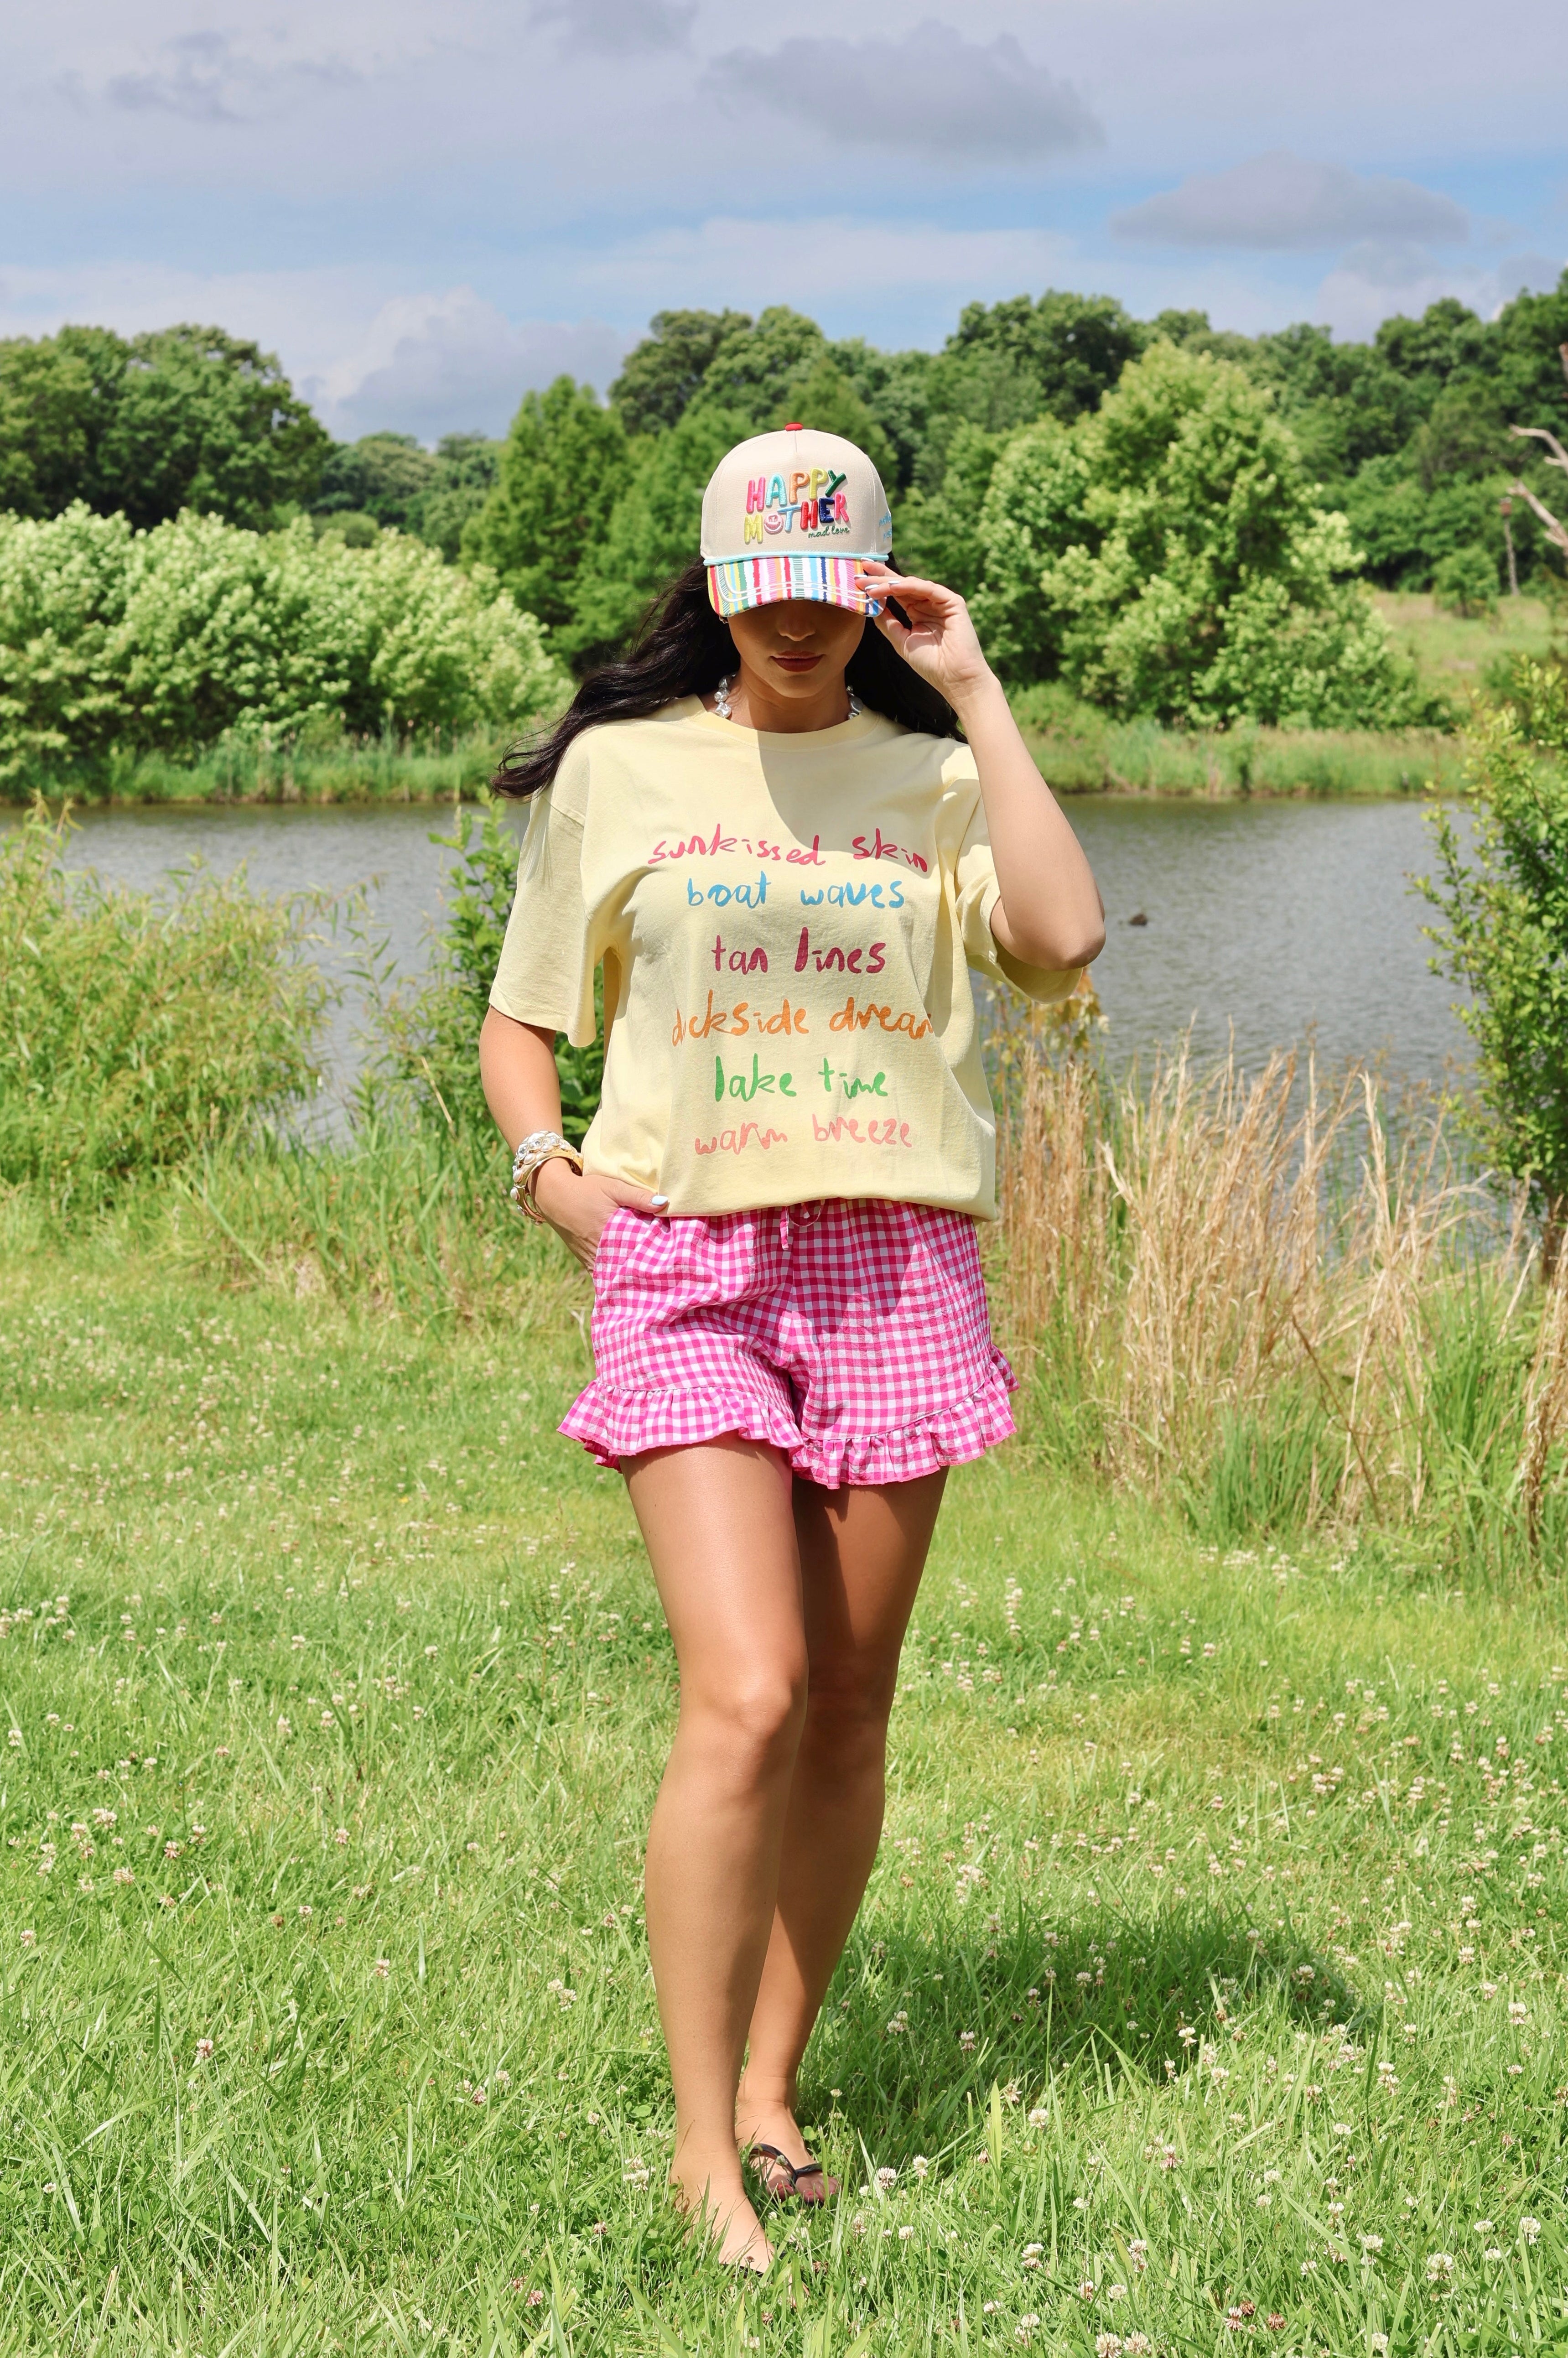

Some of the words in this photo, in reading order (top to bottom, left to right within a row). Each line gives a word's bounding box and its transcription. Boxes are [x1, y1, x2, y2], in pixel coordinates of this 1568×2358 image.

[747, 467, 847, 514] HAPPY
[808, 526, 830, 539] mad
[831, 525, 850, 535] love
[648, 823, 826, 865] sunkissed
[851, 828, 928, 873] skin
[687, 870, 772, 909] boat
[800, 880, 905, 909] waves
[711, 935, 768, 975] tan
[794, 926, 886, 973] lines
[715, 1053, 797, 1102] lake
[819, 1057, 888, 1099] time
[695, 1122, 788, 1155] warm
[812, 1114, 912, 1148] breeze
